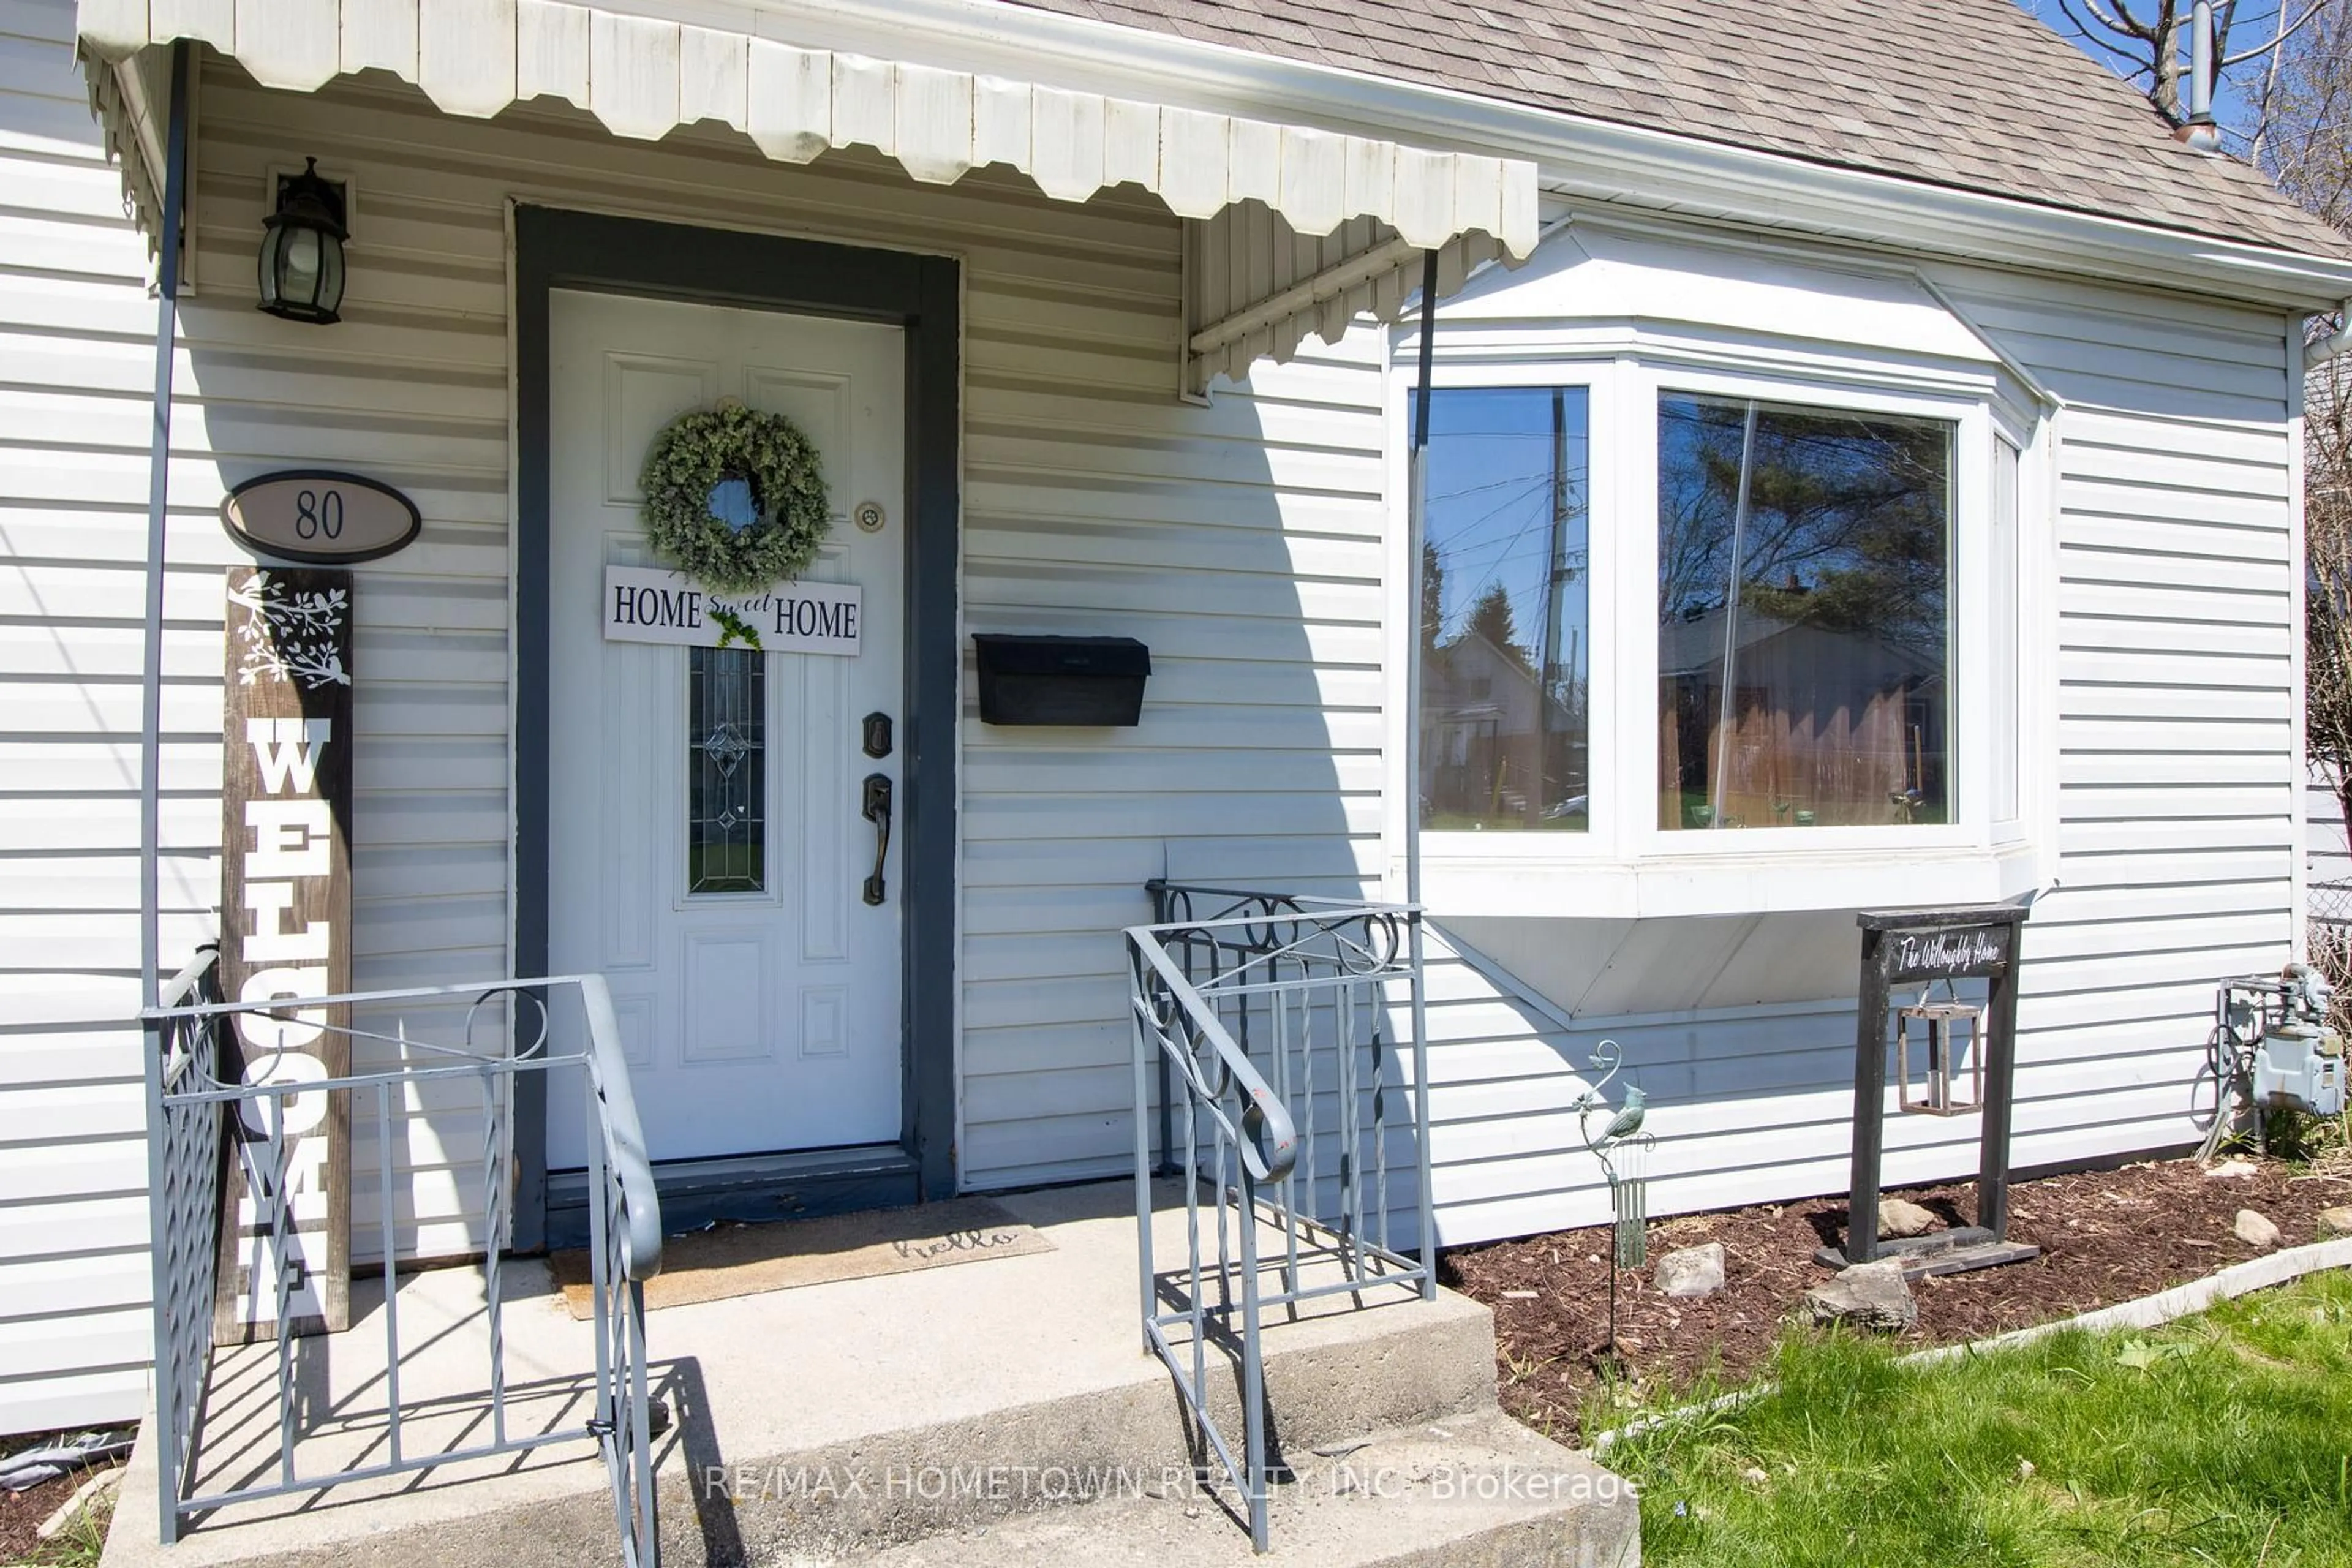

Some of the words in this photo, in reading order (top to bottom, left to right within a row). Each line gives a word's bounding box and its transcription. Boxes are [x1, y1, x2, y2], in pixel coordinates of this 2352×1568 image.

[296, 491, 343, 539] 80
[614, 586, 702, 628] HOME
[775, 598, 857, 639] HOME
[1899, 936, 1921, 971] The
[1921, 933, 1970, 973] Willoughby
[1973, 930, 1999, 964] Home
[236, 718, 331, 1323] WELCOME
[892, 1229, 1018, 1258] hello
